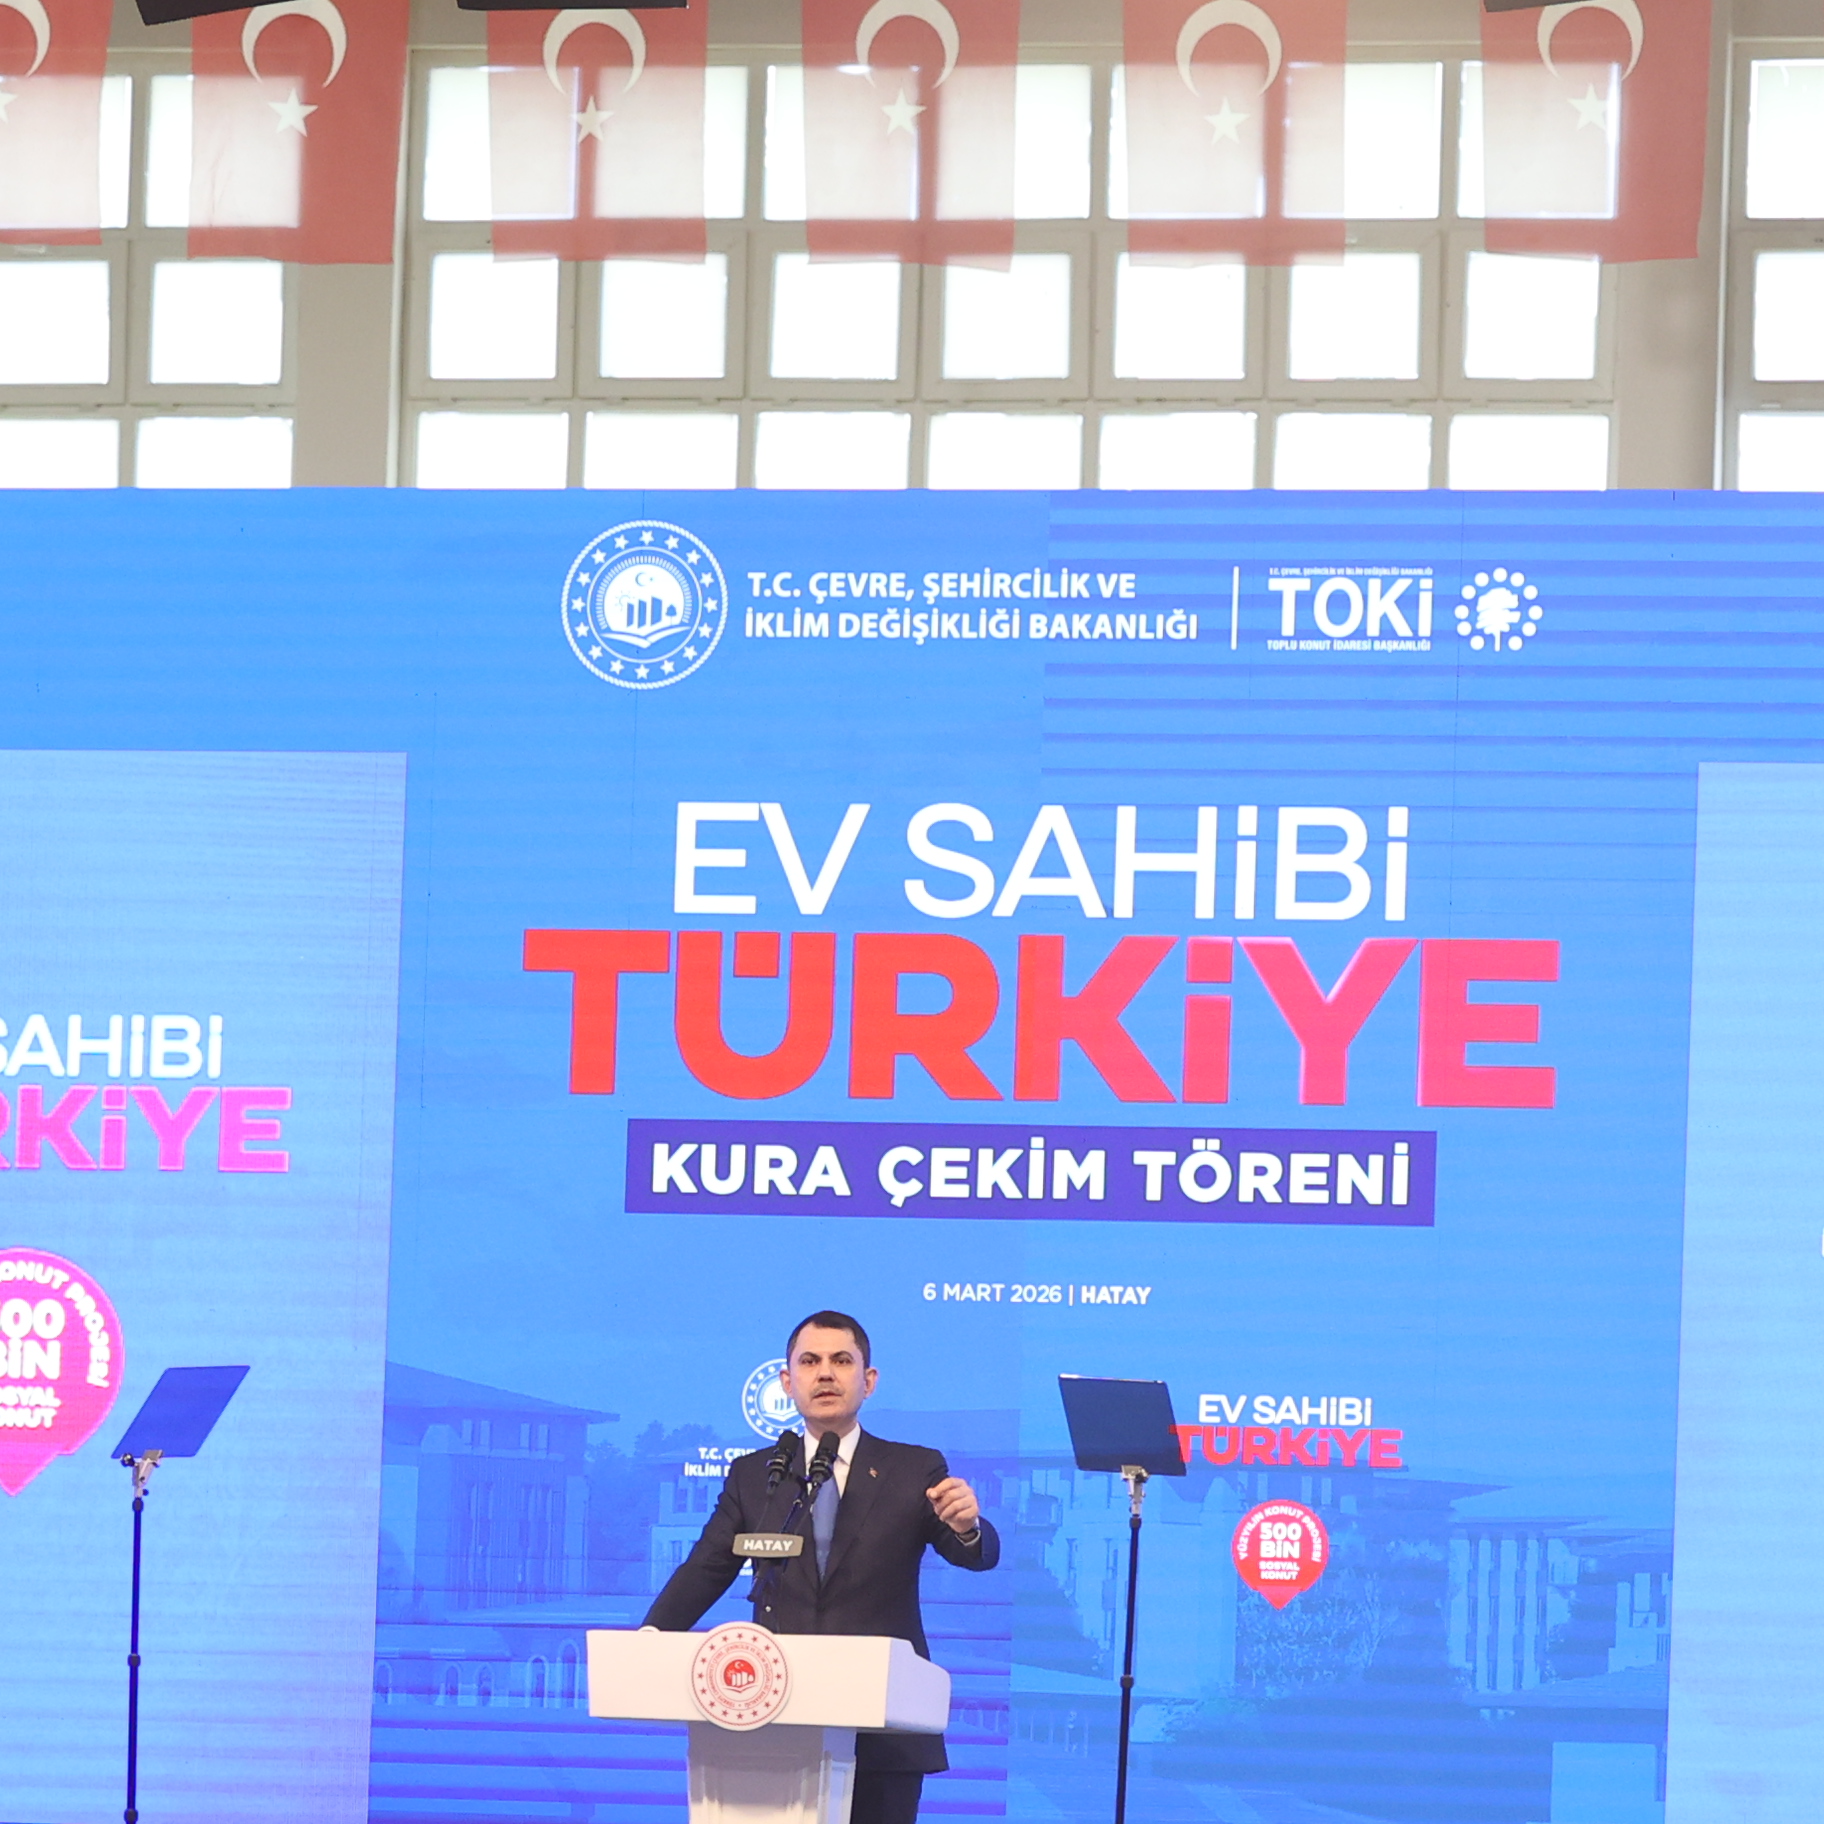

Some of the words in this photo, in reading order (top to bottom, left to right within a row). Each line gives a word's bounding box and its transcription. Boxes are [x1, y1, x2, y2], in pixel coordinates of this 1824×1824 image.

[748, 572, 801, 597] T.C.
[809, 572, 914, 604] ÇEVRE,
[923, 567, 1090, 604] ŞEHİRCİLİK
[1096, 573, 1136, 598] VE
[745, 607, 829, 638] İKLİM
[839, 607, 1020, 645] DEĞİŞİKLİĞİ
[1029, 609, 1197, 639] BAKANLIĞI
[1267, 639, 1297, 650] TOPLU
[1299, 640, 1331, 651] KONUT
[673, 801, 870, 914] EV
[650, 1142, 850, 1197] KURA
[877, 1136, 1106, 1208] ÇEKİM
[1132, 1139, 1411, 1206] TÖRENİ
[923, 1282, 937, 1301] 6
[943, 1283, 1005, 1302] MART
[1010, 1284, 1062, 1303] 2026
[1081, 1285, 1152, 1305] HATAY
[1199, 1394, 1247, 1424] EV
[698, 1447, 722, 1460] T.C.
[684, 1462, 722, 1477] İKLİM
[1264, 1505, 1304, 1518] KONUT
[1259, 1522, 1302, 1541] 500
[743, 1539, 793, 1551] HATAY
[1260, 1571, 1298, 1580] KONUT
